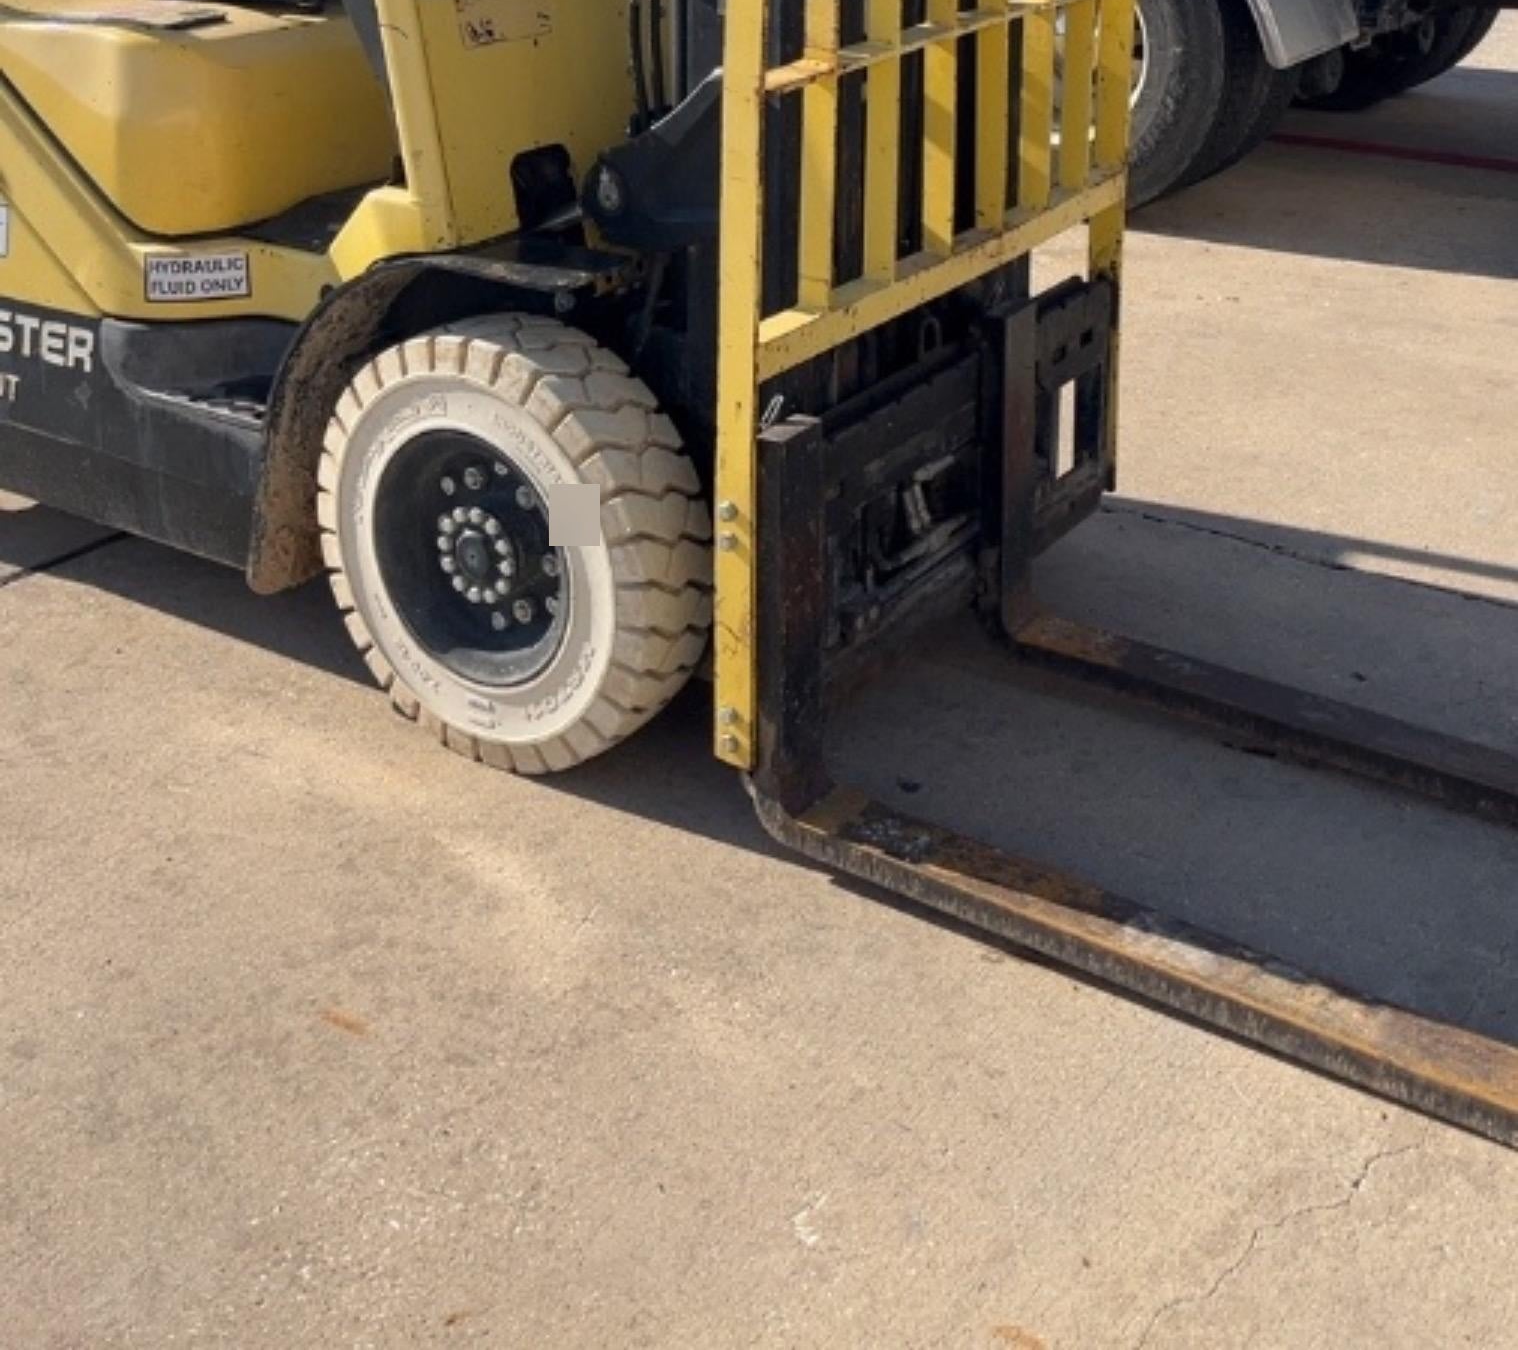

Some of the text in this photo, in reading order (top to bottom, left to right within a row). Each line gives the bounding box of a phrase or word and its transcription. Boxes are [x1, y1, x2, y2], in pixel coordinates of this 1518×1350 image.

[149, 257, 244, 274] HYDRAULIC
[151, 277, 244, 295] FLUID ONLY
